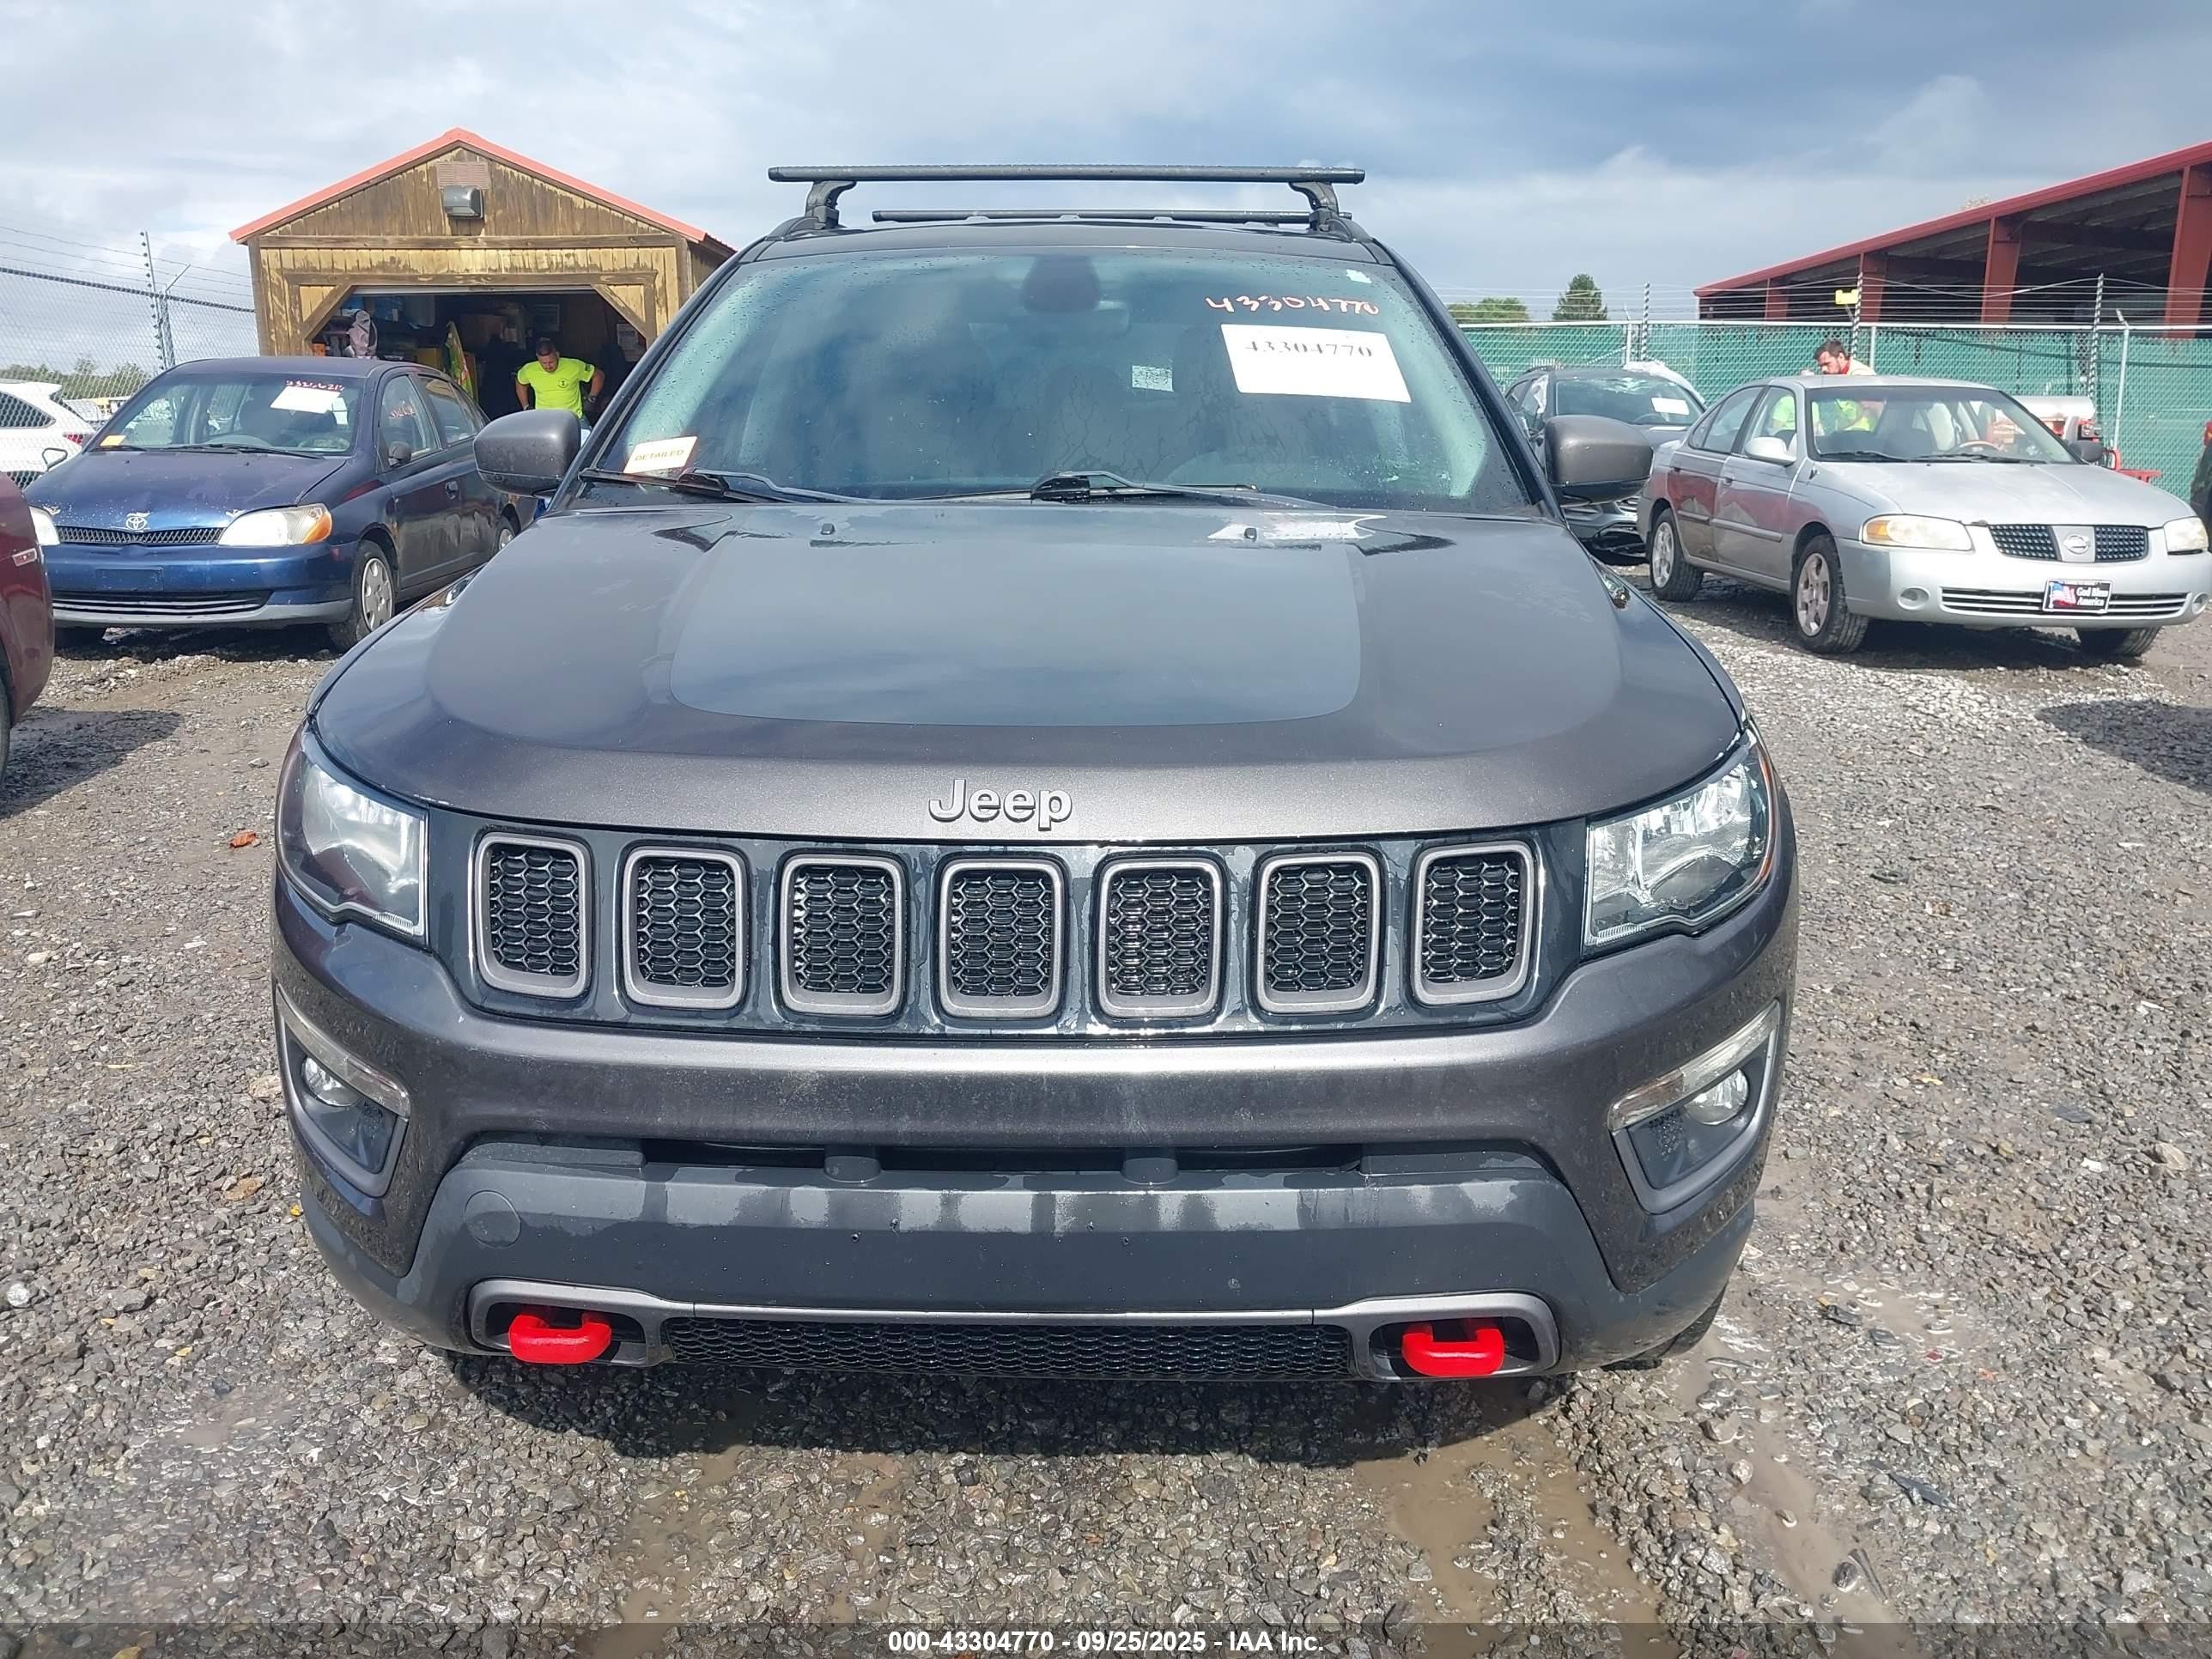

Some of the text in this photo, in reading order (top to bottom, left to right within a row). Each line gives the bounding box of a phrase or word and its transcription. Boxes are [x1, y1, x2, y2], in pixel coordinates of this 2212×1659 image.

[1205, 295, 1379, 315] 43304770
[1245, 341, 1373, 357] 43304770
[635, 449, 684, 461] DETAILED
[928, 779, 1073, 831] Jeep
